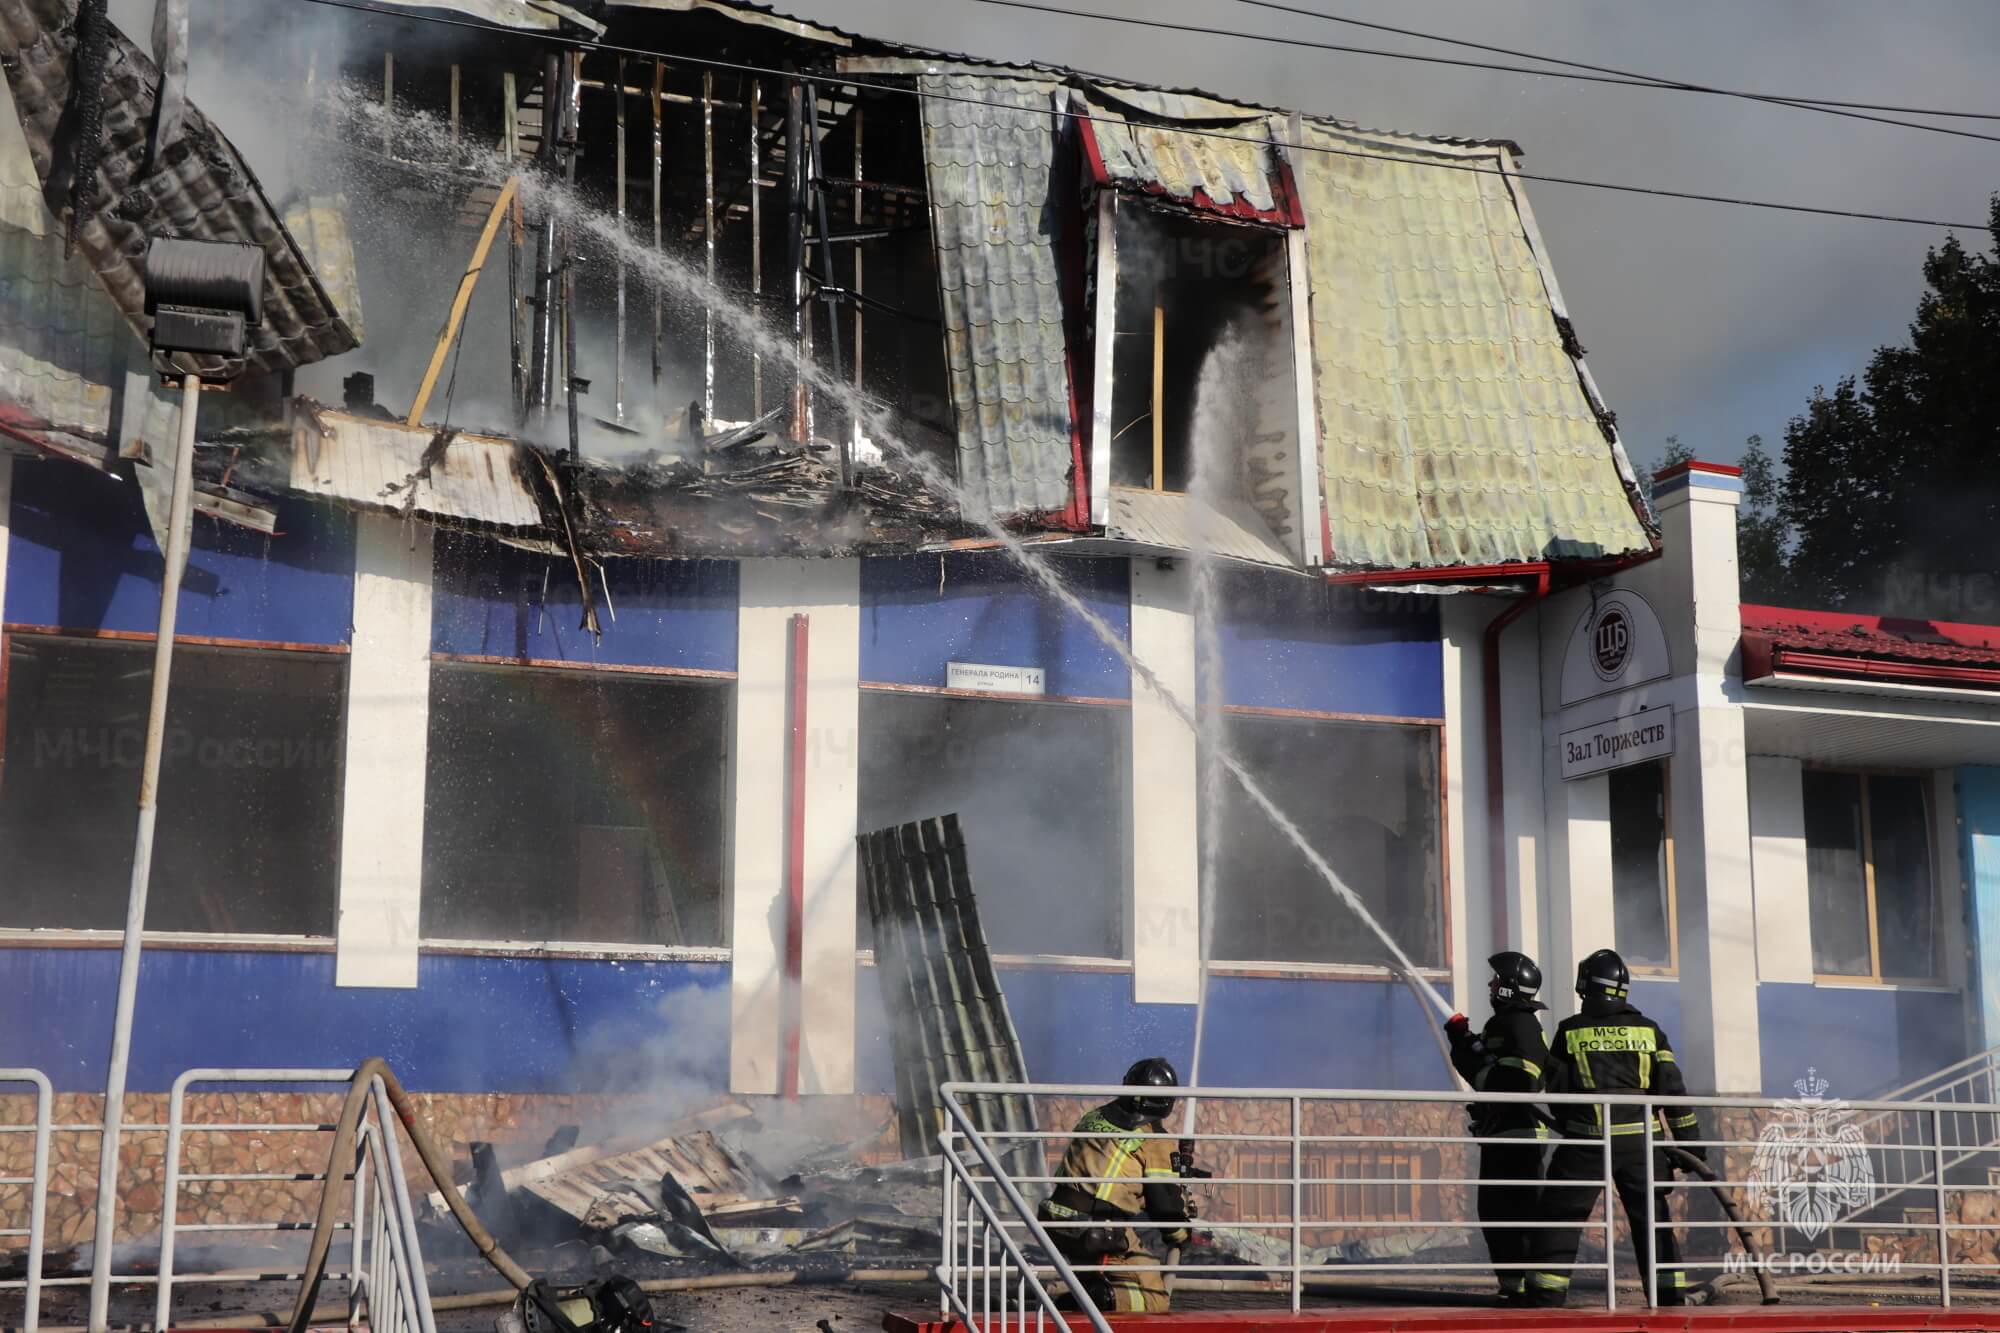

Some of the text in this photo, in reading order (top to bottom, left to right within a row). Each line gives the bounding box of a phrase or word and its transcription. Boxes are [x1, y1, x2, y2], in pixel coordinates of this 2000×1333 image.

[1599, 620, 1627, 656] ЦБ
[951, 668, 1040, 685] ГЕНЕРАЛА РОДИНА 14
[1567, 724, 1665, 763] Зал Торжеств
[1593, 1027, 1628, 1037] МЧС
[1579, 1040, 1647, 1050] РОССИИ
